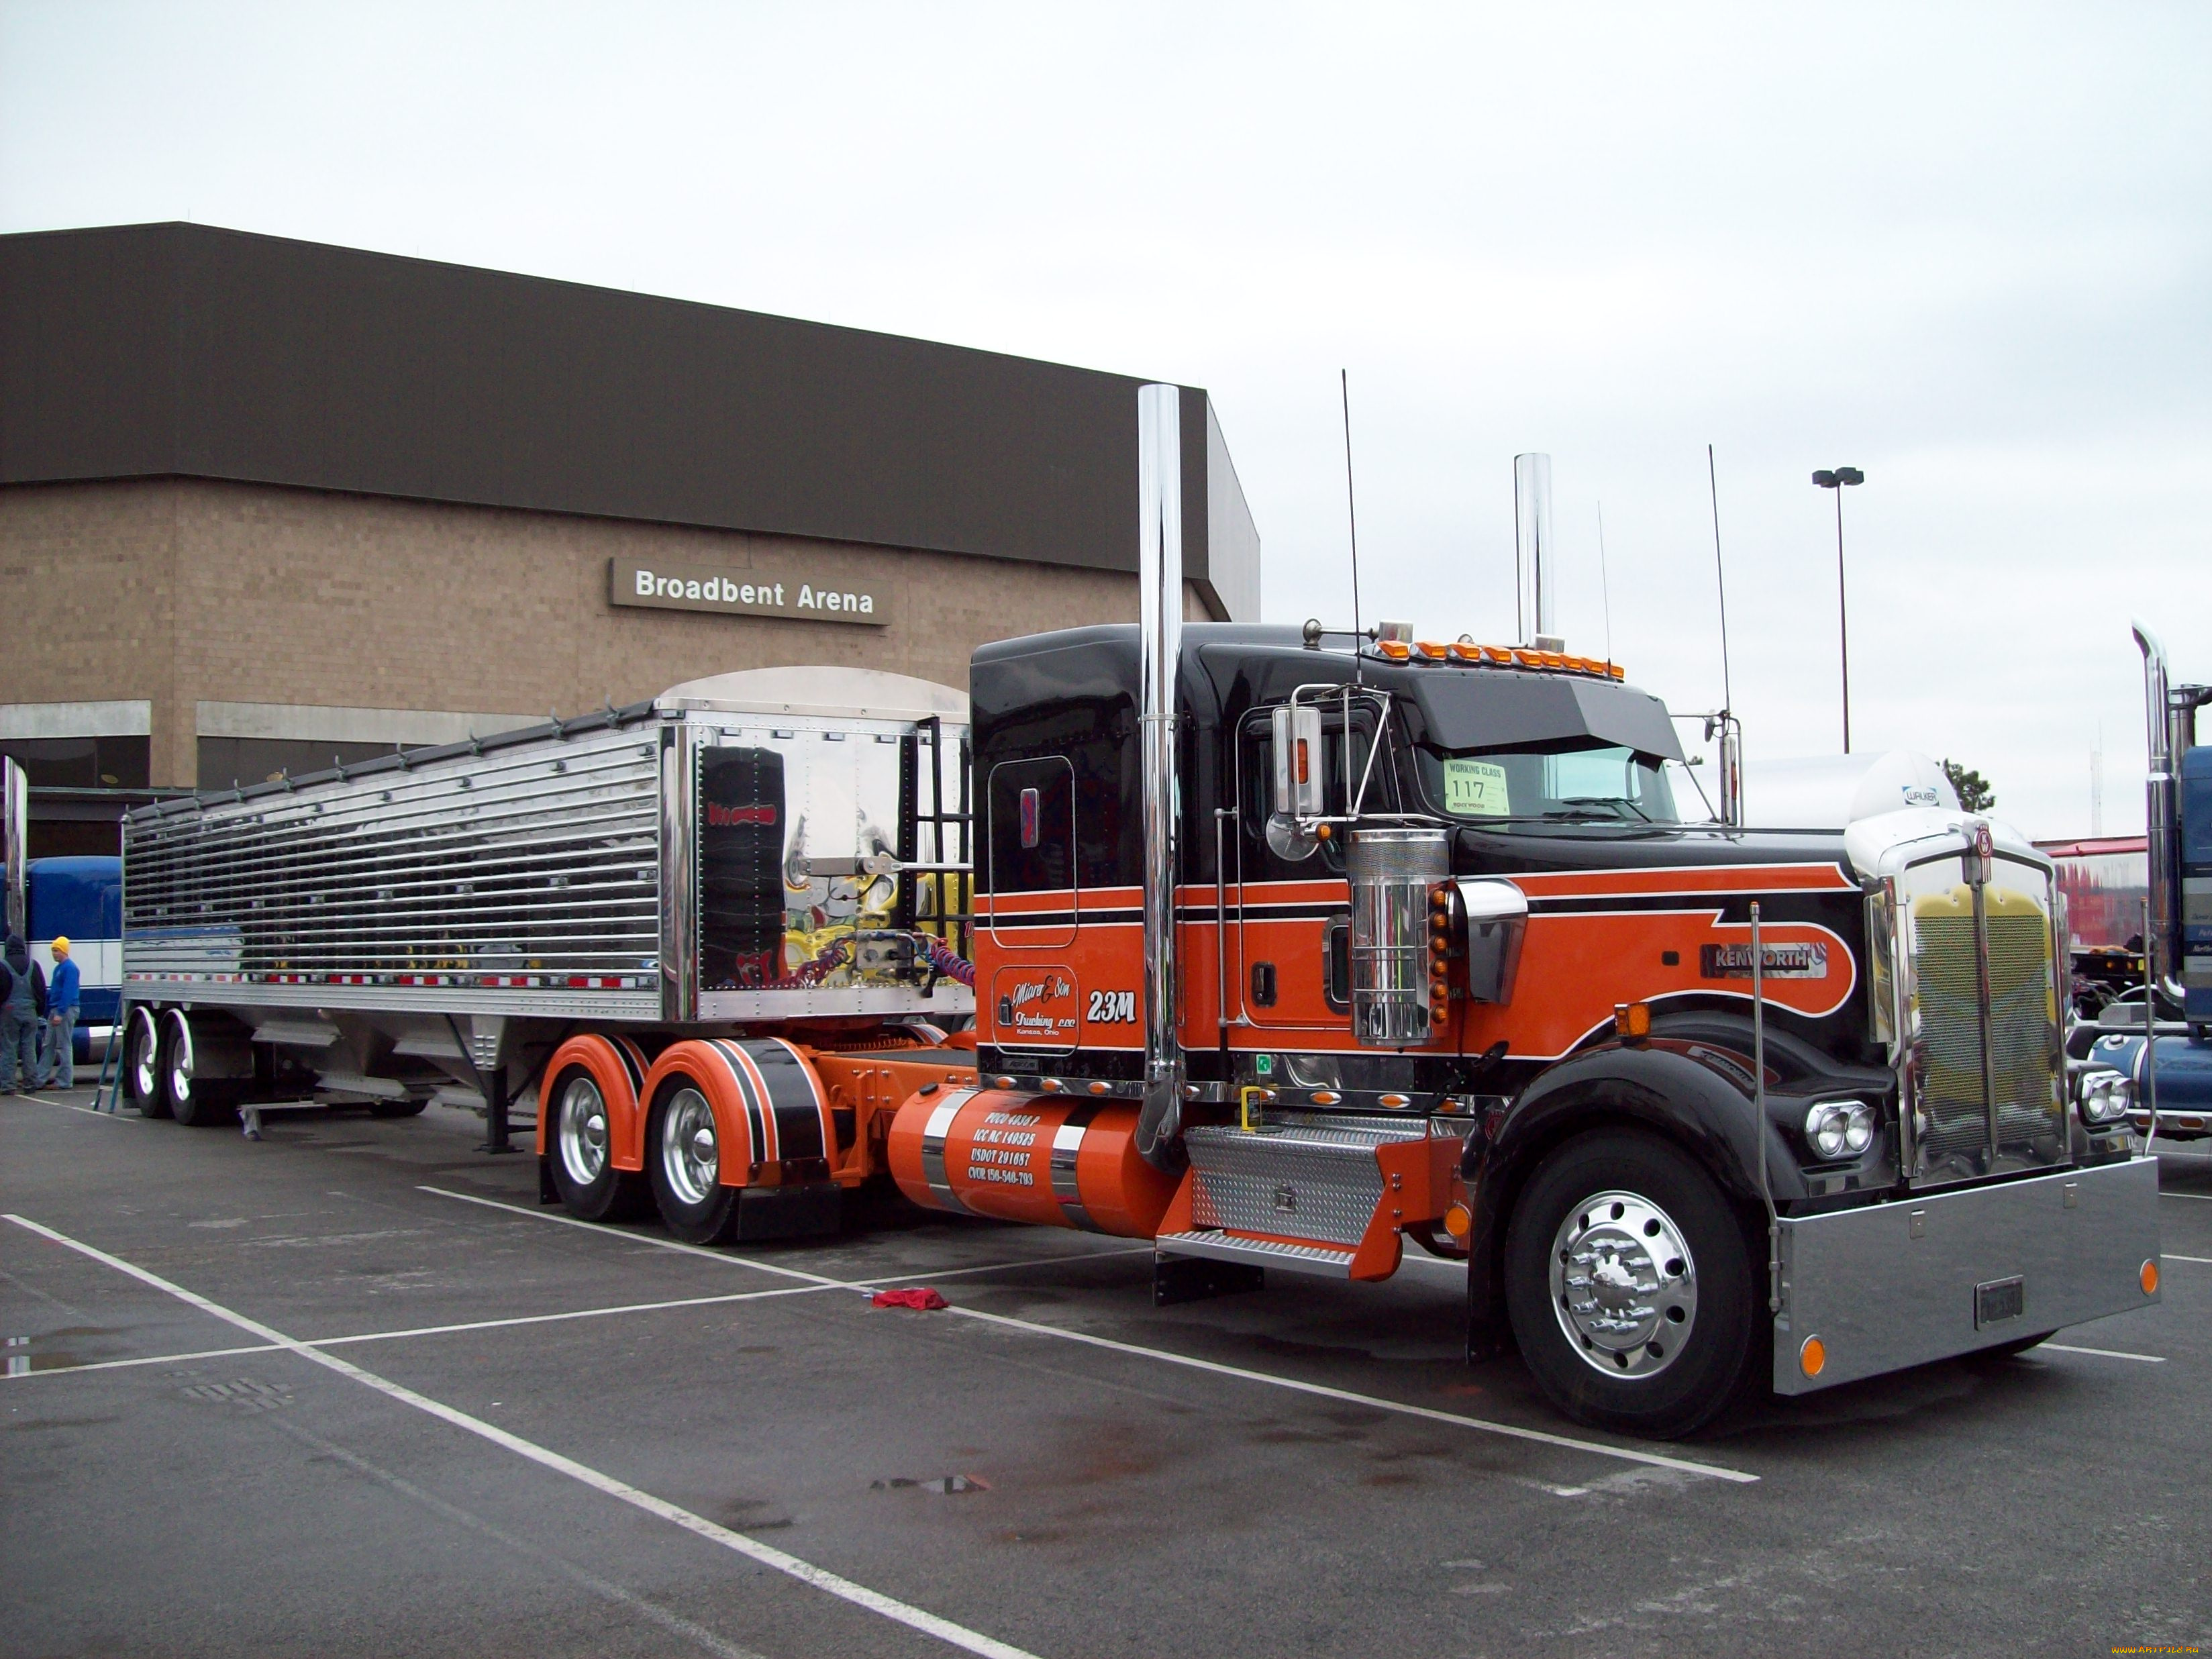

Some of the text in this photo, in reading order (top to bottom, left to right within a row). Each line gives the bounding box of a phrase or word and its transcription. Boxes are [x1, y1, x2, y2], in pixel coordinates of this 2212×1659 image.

[635, 570, 874, 613] Broadbent Arena
[1450, 764, 1501, 778] WORKING CLASS
[1453, 780, 1484, 799] 117
[1906, 791, 1938, 802] WALKER
[1715, 950, 1808, 967] KENWORTH
[1054, 976, 1070, 998] Son
[1086, 989, 1136, 1024] 23M
[1015, 1011, 1053, 1029] Trucking
[972, 1128, 990, 1142] ICC
[970, 1148, 997, 1163] USDOT
